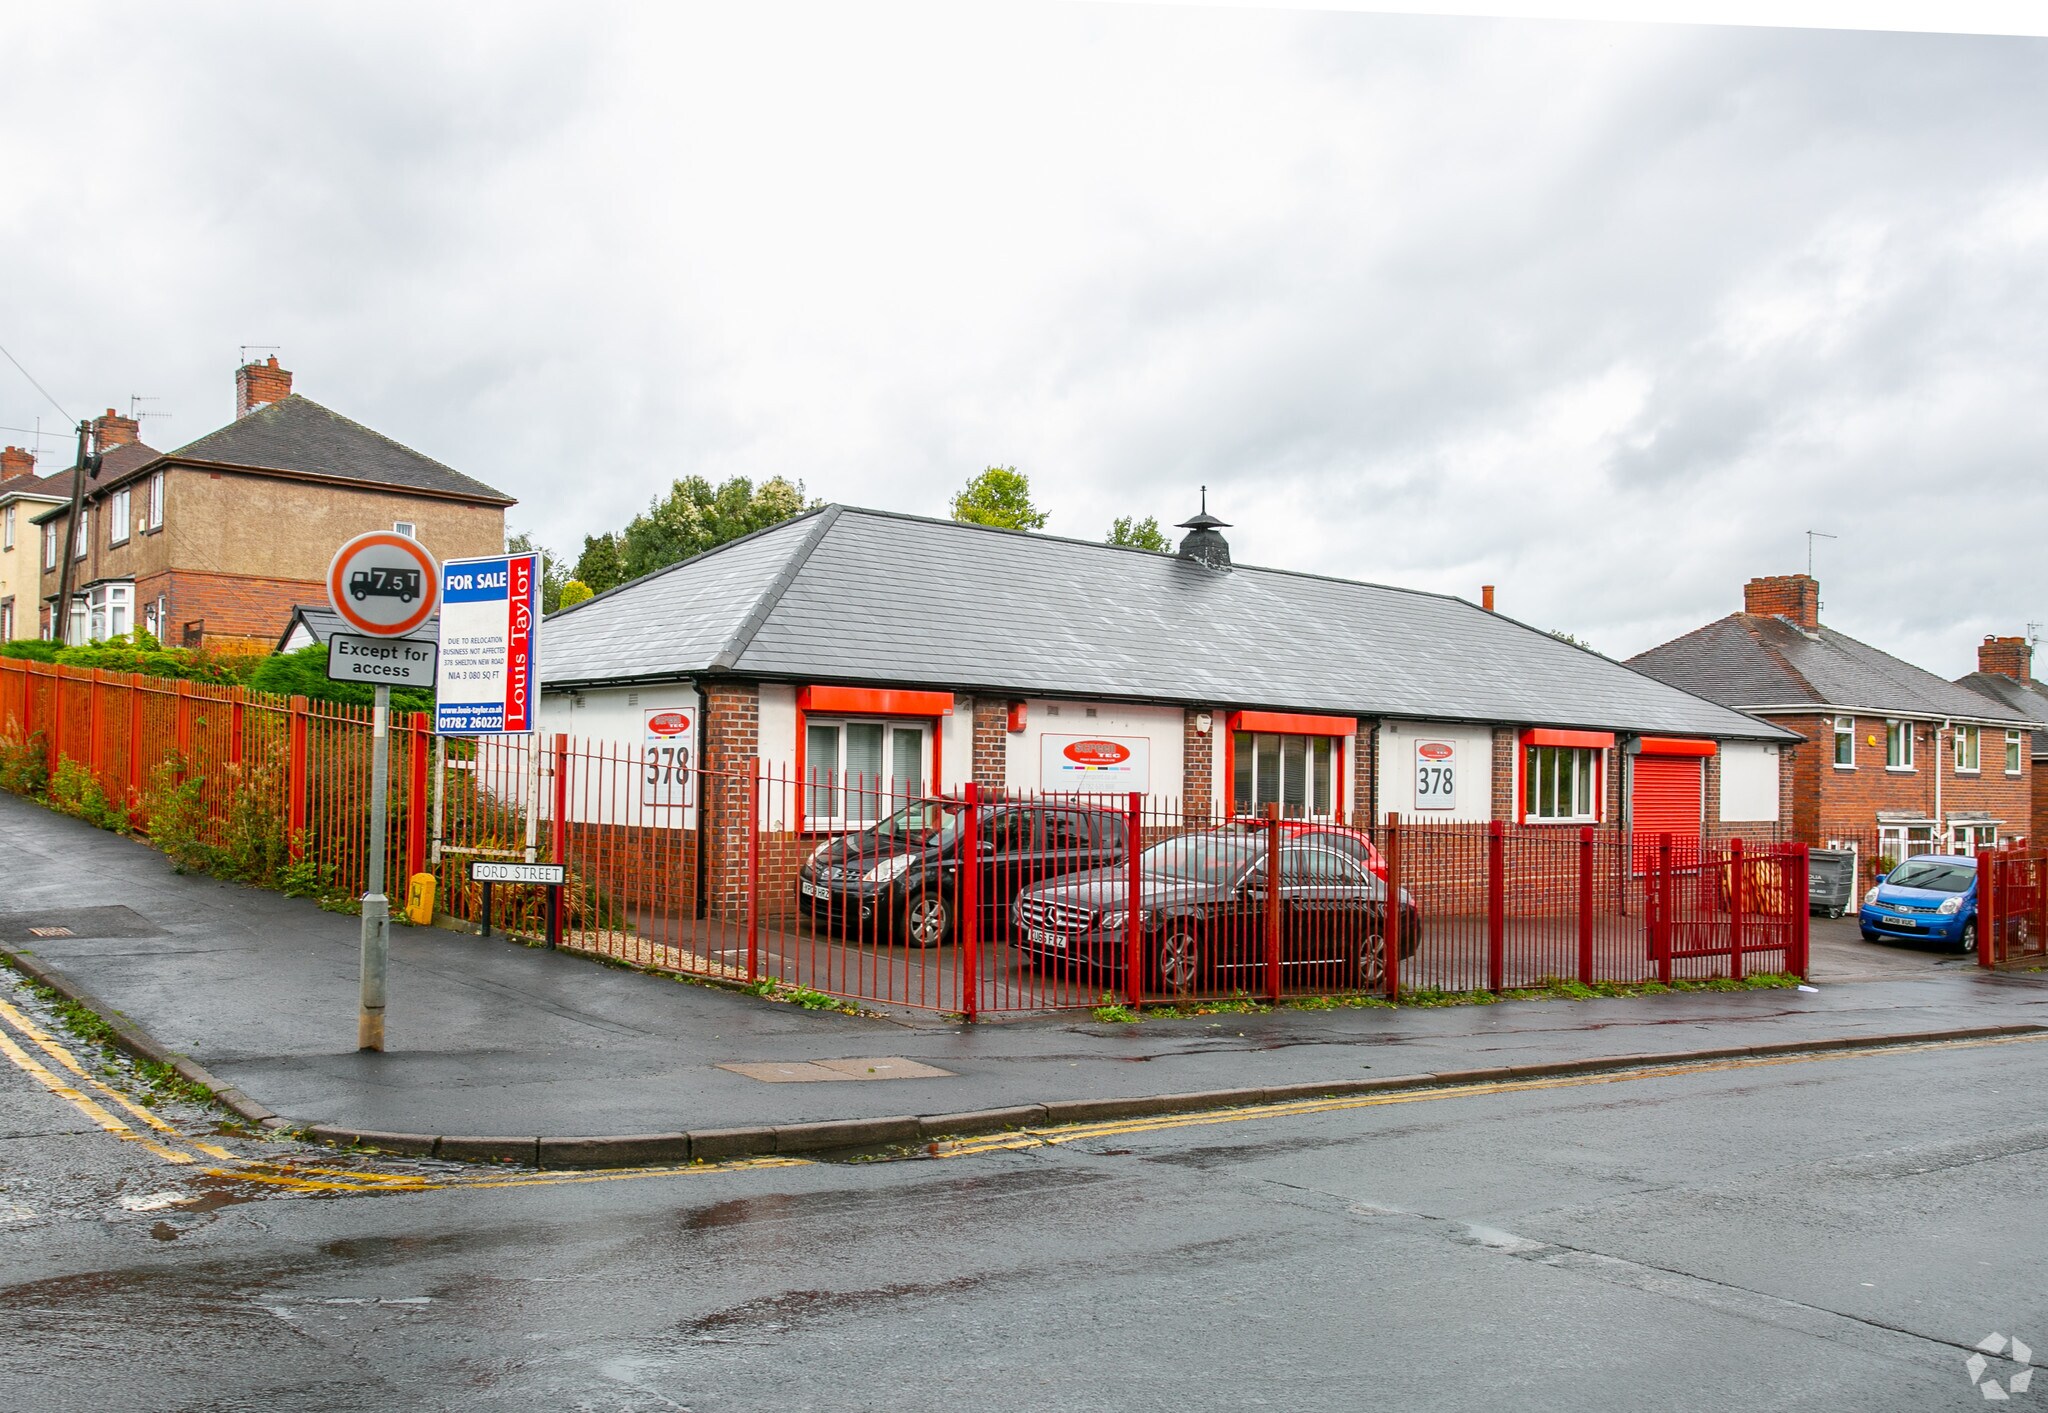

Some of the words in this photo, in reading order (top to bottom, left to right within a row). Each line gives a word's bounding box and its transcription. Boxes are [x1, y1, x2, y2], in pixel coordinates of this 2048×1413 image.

[373, 571, 403, 591] 7.5
[408, 573, 418, 587] T
[446, 574, 473, 591] FOR
[477, 571, 507, 589] SALE
[511, 566, 532, 647] Taylor
[447, 637, 460, 645] DUE
[470, 636, 503, 644] RELOCATION
[338, 641, 398, 661] Except
[404, 647, 429, 662] for
[443, 648, 469, 656] BUSINESS
[482, 646, 506, 654] AFFECTED
[352, 662, 410, 678] access
[454, 658, 477, 666] SHELTON
[448, 671, 461, 680] NIA
[463, 671, 468, 680] 3
[469, 671, 481, 680] 080
[482, 671, 491, 680] SQ
[492, 670, 500, 679] FT
[508, 653, 526, 722] Louis
[440, 705, 503, 715] www.louis-taylor.co.uk
[440, 717, 467, 729] 01782
[469, 716, 502, 729] 260222
[647, 746, 690, 785] 378
[1418, 767, 1453, 795] 378
[476, 865, 508, 879] FORD
[514, 866, 561, 881] STREET
[1048, 934, 1065, 947] FZ
